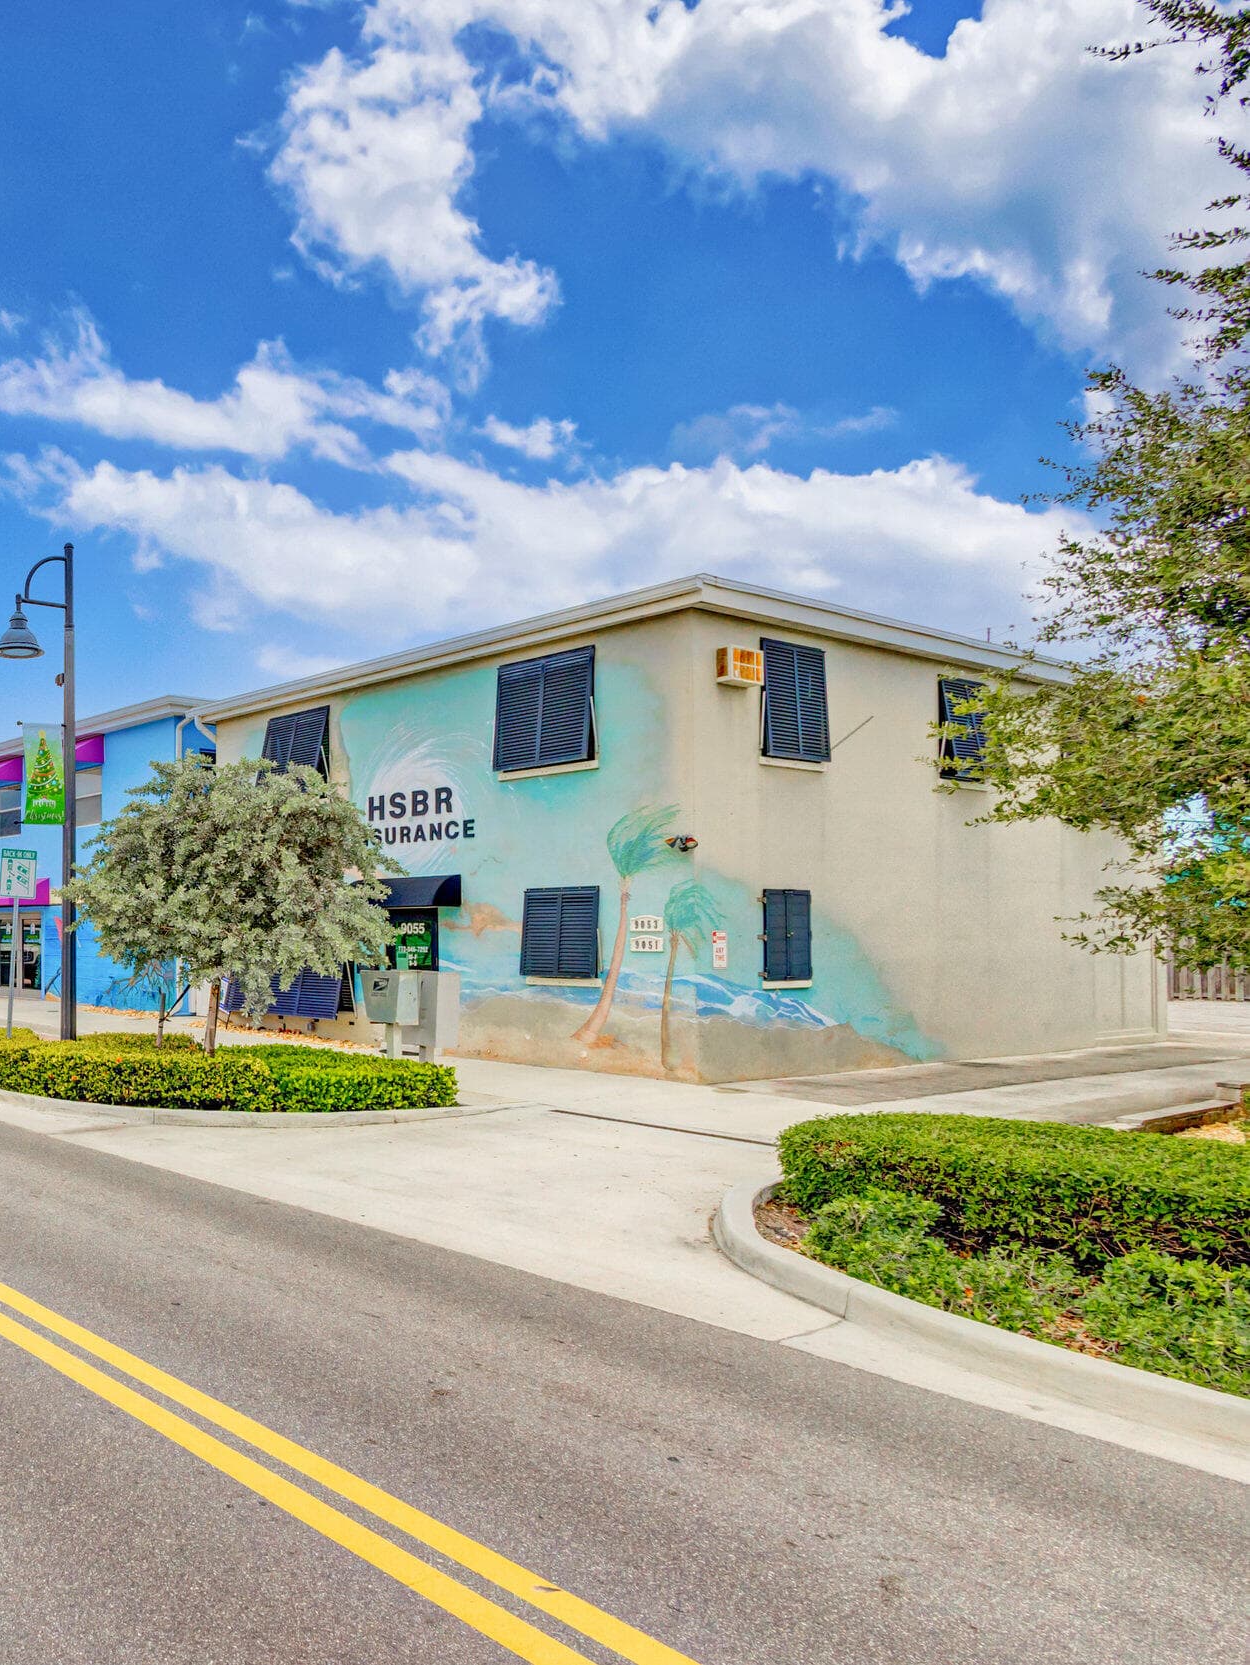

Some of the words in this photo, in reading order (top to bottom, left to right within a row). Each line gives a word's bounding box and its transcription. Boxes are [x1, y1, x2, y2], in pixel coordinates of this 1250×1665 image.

[368, 787, 453, 821] HSBR
[363, 819, 475, 847] SURANCE
[400, 922, 425, 935] 9055
[634, 920, 659, 930] 9053
[635, 940, 659, 950] 9051
